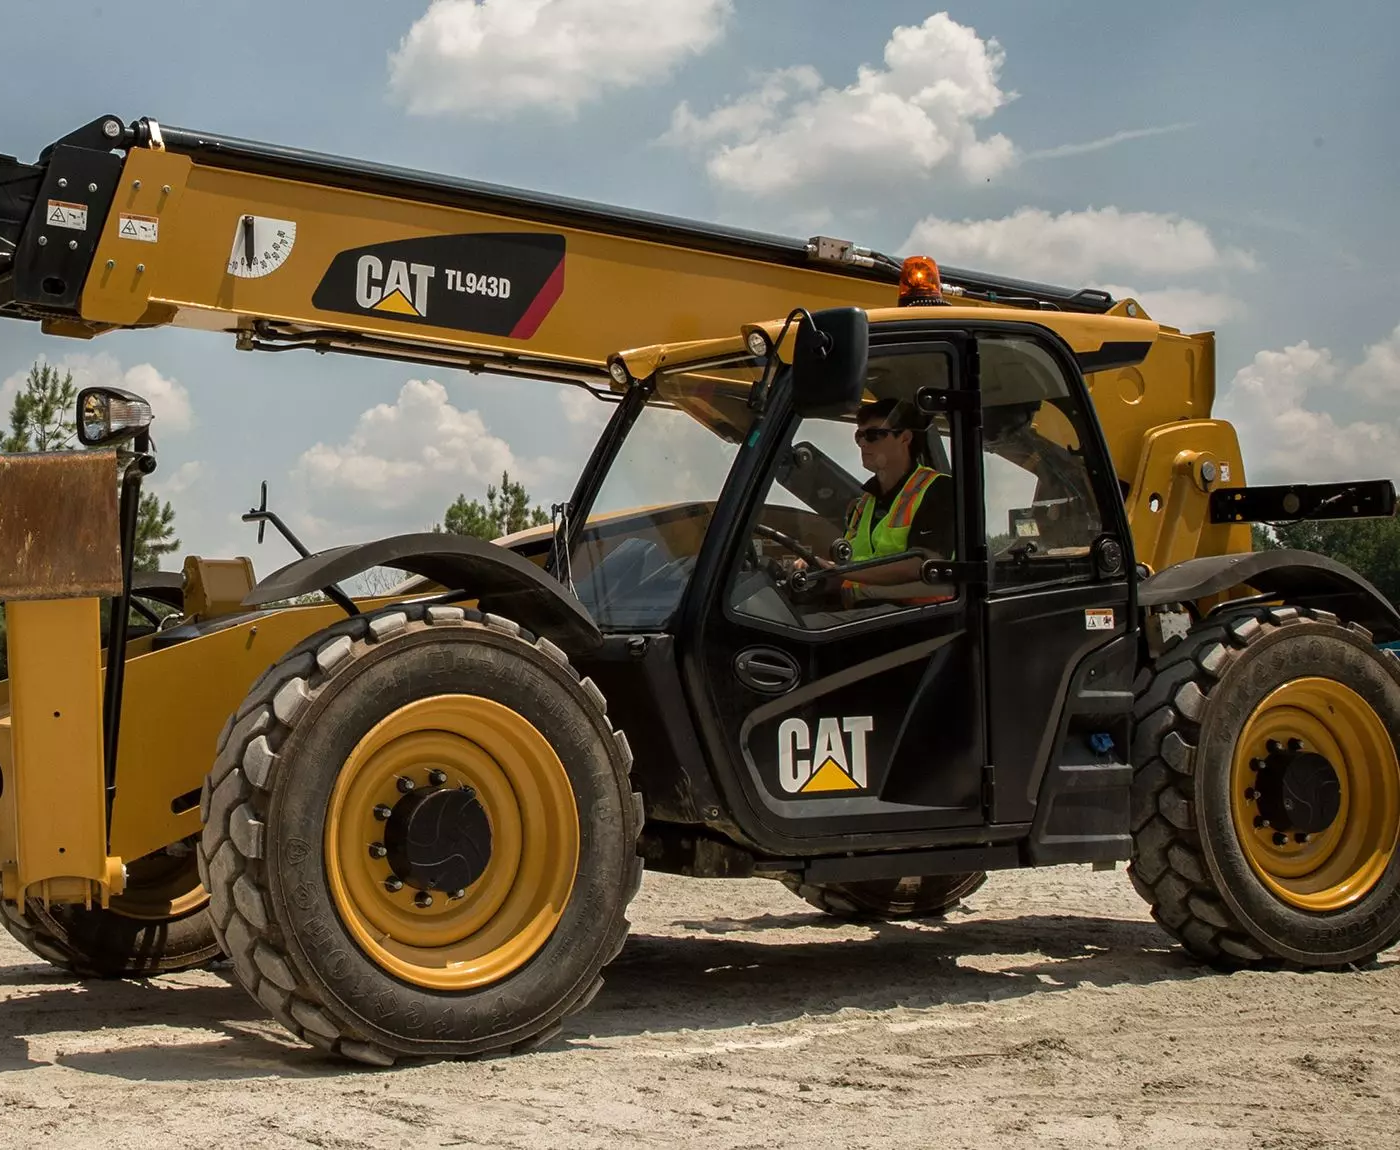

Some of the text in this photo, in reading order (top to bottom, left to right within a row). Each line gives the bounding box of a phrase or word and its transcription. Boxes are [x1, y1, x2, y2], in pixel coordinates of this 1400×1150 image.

[355, 254, 511, 317] CAT TL943D
[778, 715, 873, 793] CAT
